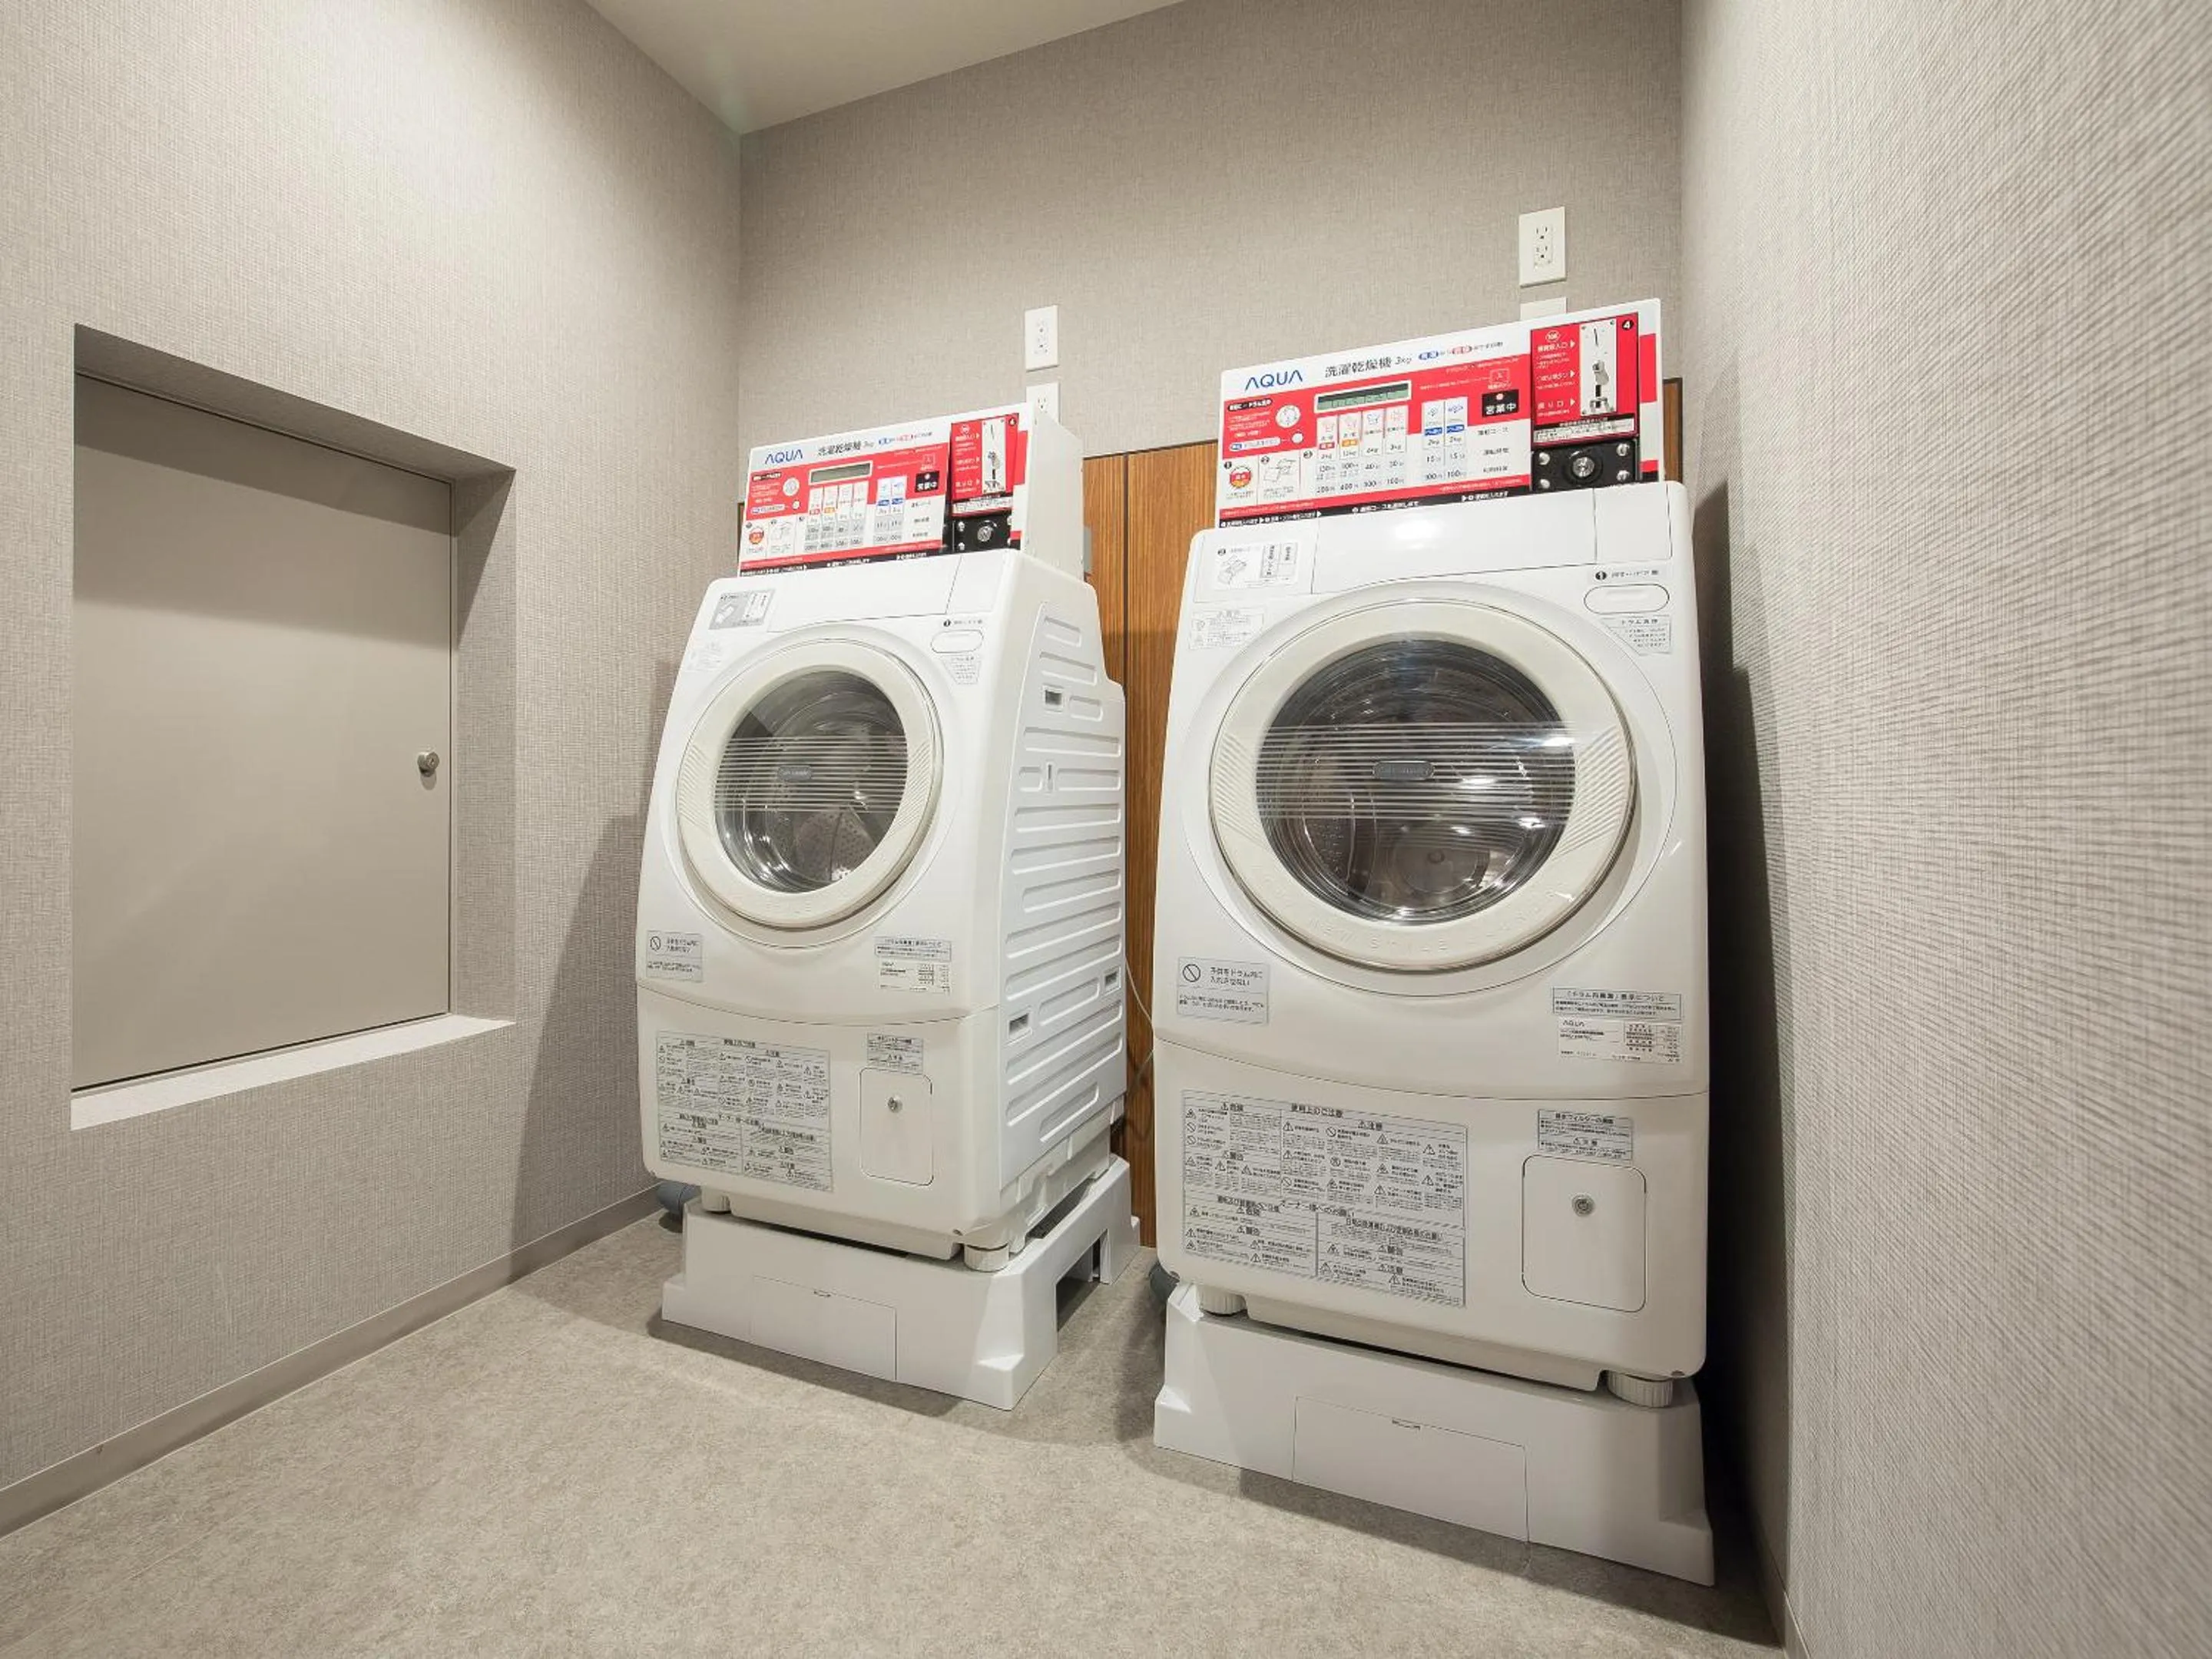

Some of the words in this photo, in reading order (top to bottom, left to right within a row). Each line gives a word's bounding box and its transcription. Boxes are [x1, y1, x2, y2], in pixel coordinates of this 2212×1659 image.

[1325, 356, 1392, 378] 洗濯乾燥機
[1245, 369, 1303, 392] AQUA
[1485, 402, 1517, 416] 営業中
[764, 449, 803, 465] AQUA
